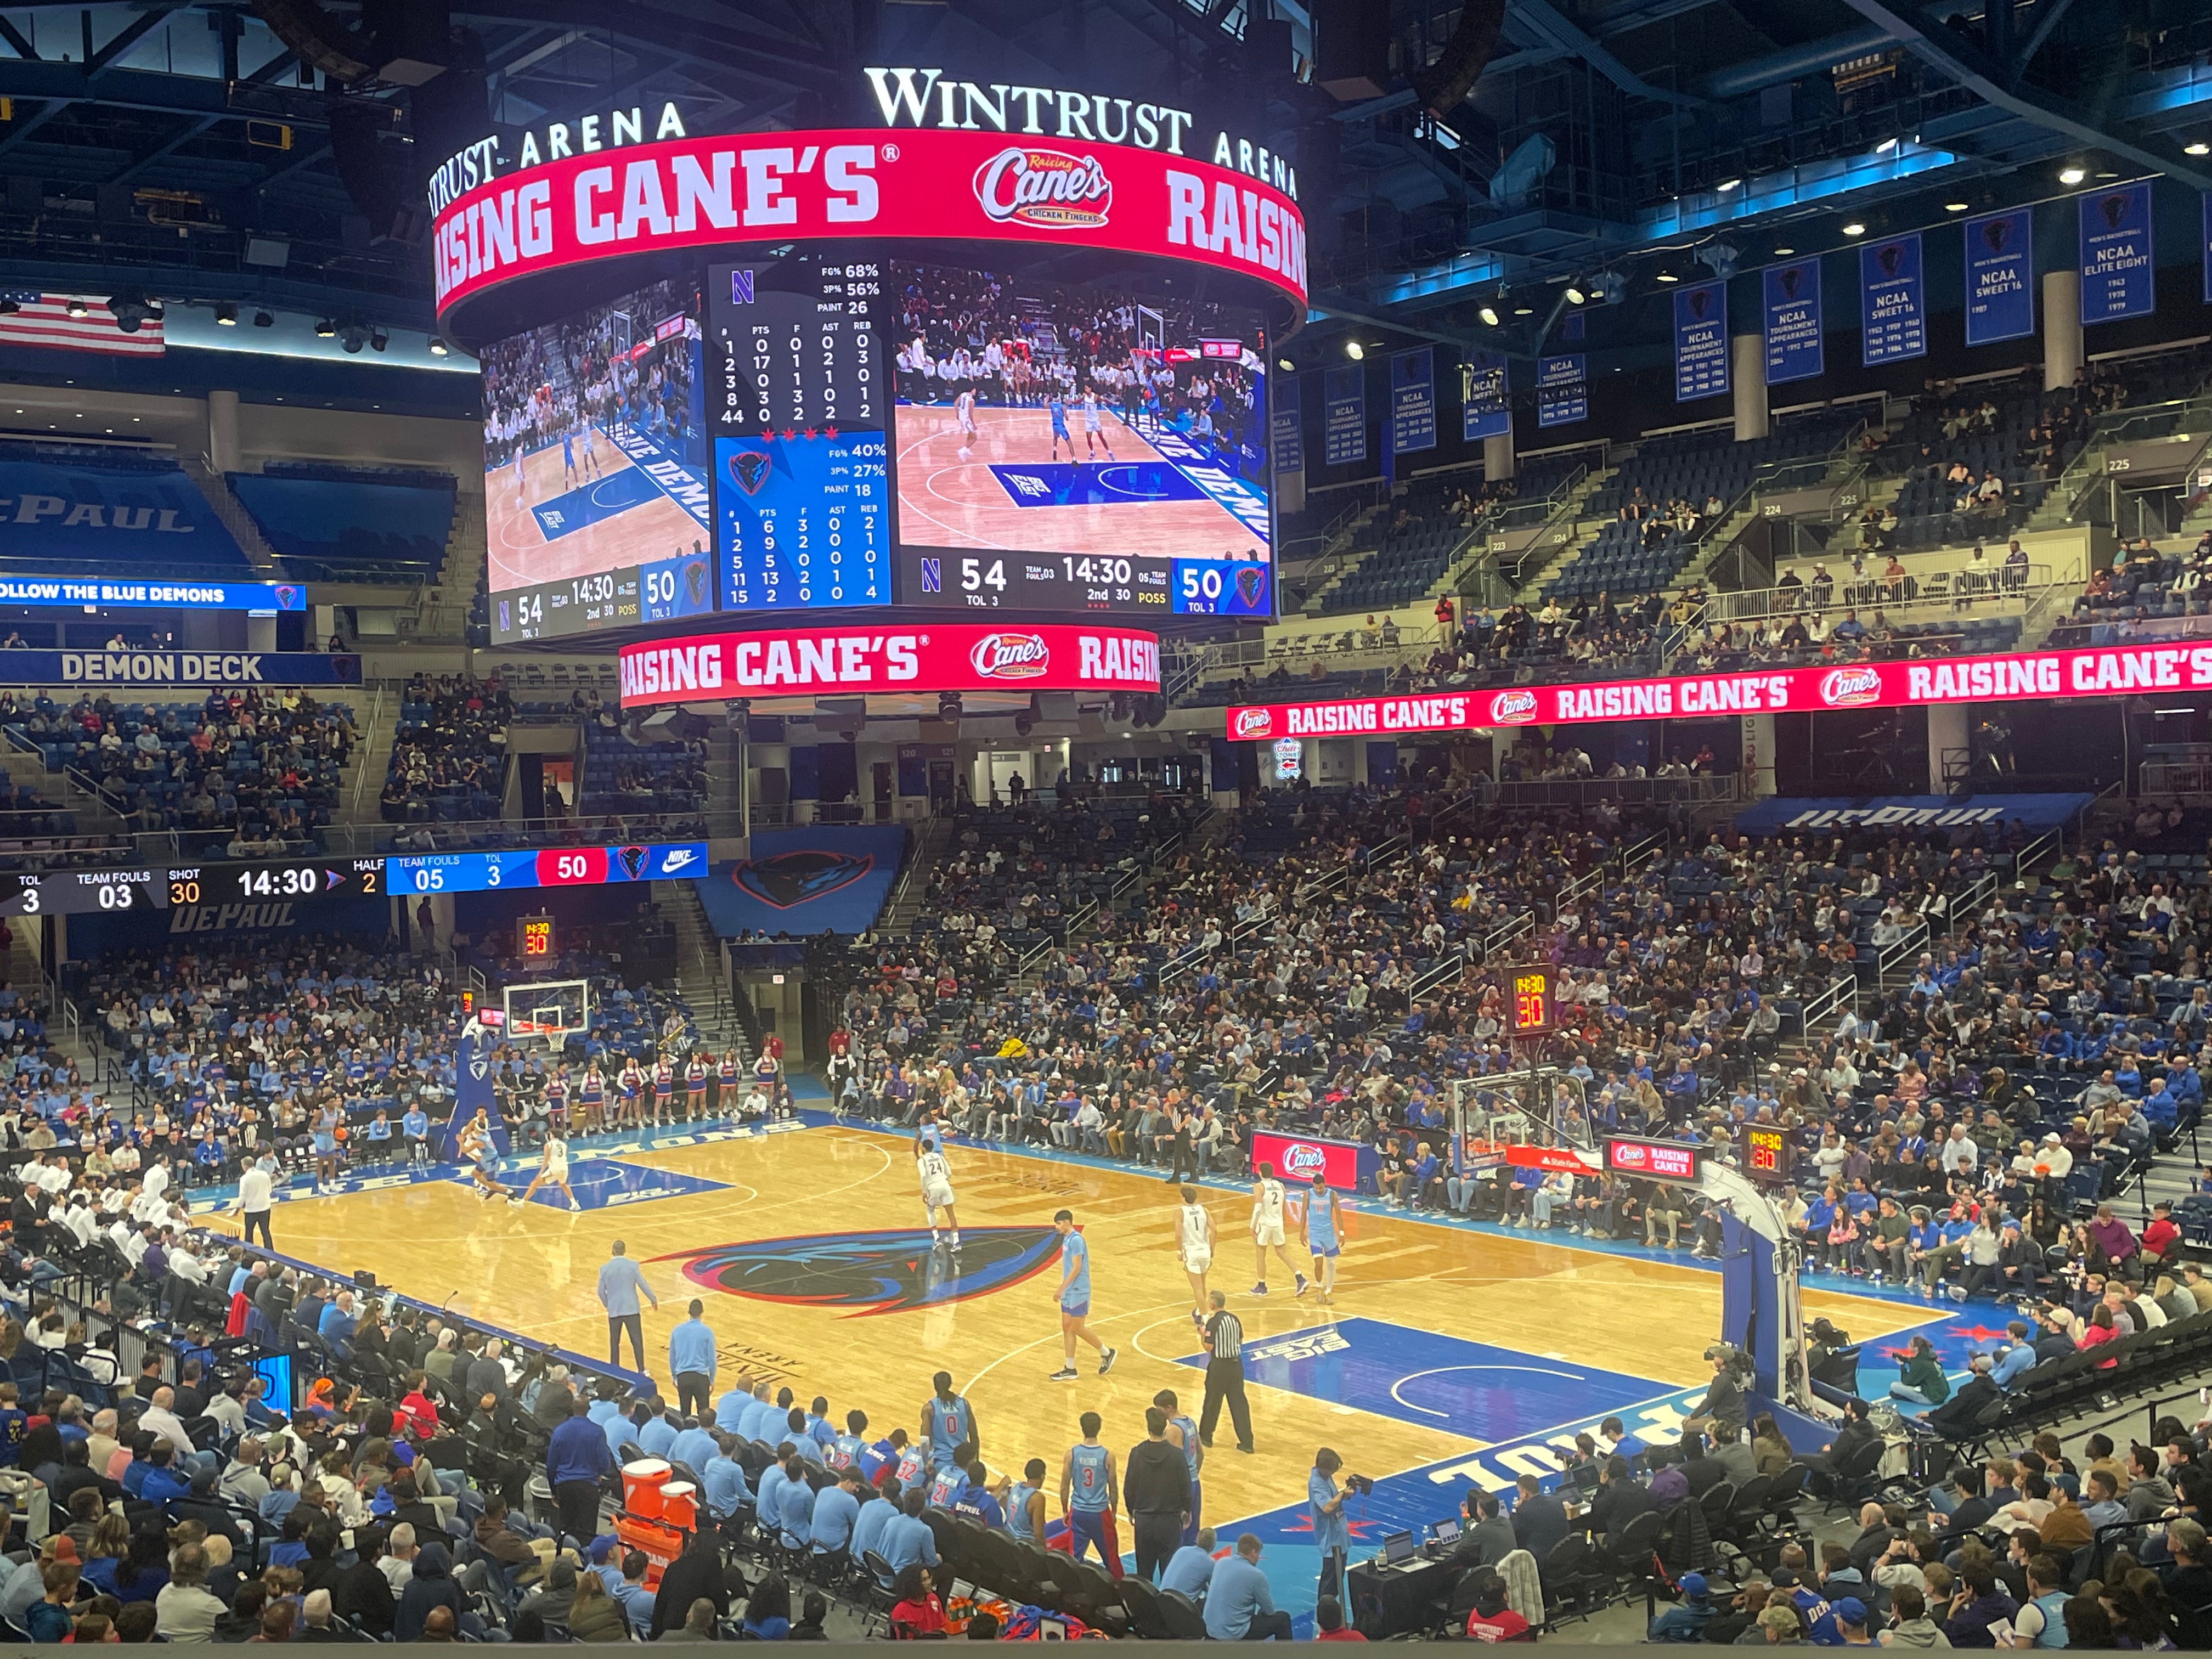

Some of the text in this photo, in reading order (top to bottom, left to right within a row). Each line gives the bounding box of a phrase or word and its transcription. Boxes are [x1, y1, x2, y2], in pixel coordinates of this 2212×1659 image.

[864, 68, 1297, 200] WINTRUST ARENA
[428, 103, 685, 217] TRUST ARENA
[1029, 155, 1073, 171] Raising
[983, 148, 1111, 218] Cane's
[1028, 208, 1098, 223] CHICKEN FINGERS
[1167, 171, 1307, 293] RAISIN
[2097, 245, 2134, 262] NCAA
[822, 264, 878, 278] FG% 68%
[2085, 255, 2148, 275] ELITE EIGHT
[1982, 269, 2016, 285] NCAA
[823, 283, 879, 296] 3P% 56%
[1976, 281, 2022, 298] SWEET 16
[817, 301, 867, 314] PAINT 26
[1877, 291, 1909, 308] NCAA
[1779, 311, 1806, 325] NCAA
[1872, 303, 1914, 319] SWEET 16
[752, 326, 770, 335] PTS
[823, 323, 839, 331] AST
[854, 321, 871, 330] REB
[1769, 328, 1818, 344] APPEARANCES
[1770, 319, 1816, 335] TOURNAMENT
[726, 334, 868, 354] 1 0 0 0 0
[1689, 331, 1713, 345] NCAA
[725, 351, 868, 371] 2 17 1 2 3
[726, 369, 870, 388] 3 0 1 1 0
[852, 444, 887, 457] 40%
[854, 465, 885, 477] 27%
[2109, 459, 2130, 471] 225
[825, 484, 871, 496] PAINT 18
[1764, 495, 1857, 516] 224 225
[733, 516, 874, 534] 1 6 3 0 2
[732, 532, 873, 552] 2 9 2 0 1
[1493, 534, 1567, 551] 223 224
[961, 557, 1221, 599] 54 03 14:30 05 50
[63, 585, 97, 599] THE
[101, 585, 146, 601] BLUE
[149, 587, 225, 602] DEMONS
[518, 594, 542, 625] 54
[572, 574, 613, 605] 14:30
[647, 570, 675, 605] 50
[1087, 589, 1166, 603] 2nd 30 POSS
[973, 634, 1048, 677] Cane's
[62, 654, 263, 681] DEMON DECK
[1822, 668, 1882, 703] Cane's
[1909, 658, 2060, 700] RAISING
[1493, 692, 1536, 723] Cane's
[1558, 685, 1667, 719] RAISING
[1236, 709, 1271, 737] Cane's
[1288, 703, 1376, 733] RAISING
[901, 748, 953, 758] 120 121
[398, 854, 502, 867] TEAM FOULS TOL
[19, 859, 385, 885] TOL TEAM FOULS SHOT HALF
[415, 849, 692, 891] 05 3 50 NIKE
[22, 868, 376, 913] 3 03 30 14:30 2
[526, 923, 549, 934] 14:30
[526, 935, 547, 955] 30
[1516, 974, 1545, 994] 14:30
[1518, 995, 1544, 1028] 30
[1751, 1132, 1781, 1150] 14:30
[1285, 1144, 1324, 1171] Cane's
[1551, 1157, 1581, 1169] State Farm
[1651, 1148, 1689, 1163] RAISING
[1754, 1149, 1775, 1170] 30
[929, 1162, 943, 1175] 24
[1655, 1160, 1686, 1173] CANE'S
[1272, 1192, 1278, 1205] 2
[1194, 1216, 1199, 1231] 1
[946, 1415, 957, 1435] 0
[834, 1452, 850, 1470] 22
[896, 1460, 917, 1481] 32
[1083, 1467, 1093, 1488] 3
[933, 1483, 949, 1504] 21
